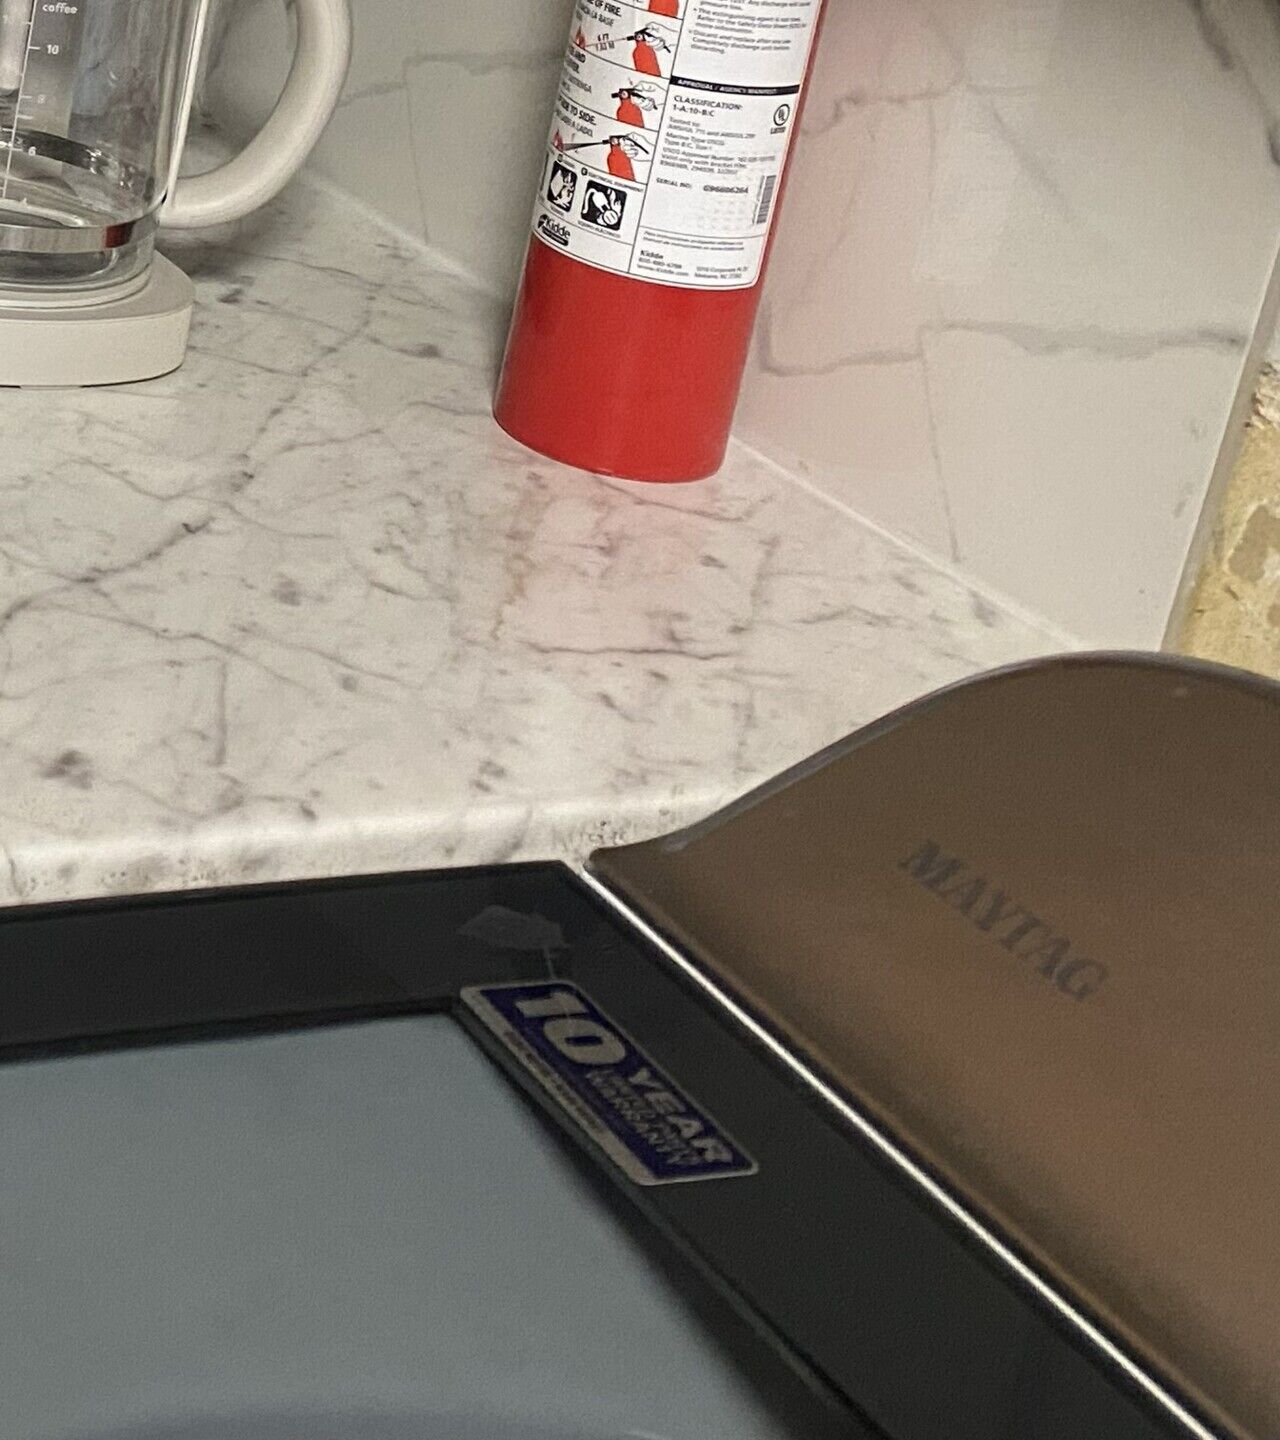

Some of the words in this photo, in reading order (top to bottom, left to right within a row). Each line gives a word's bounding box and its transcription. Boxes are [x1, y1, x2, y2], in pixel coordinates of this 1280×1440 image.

[42, 2, 78, 14] coffee
[46, 44, 59, 55] 10
[27, 146, 37, 157] 6
[546, 216, 571, 238] Kidde
[898, 838, 1109, 1002] MAYTAG
[514, 990, 627, 1066] 10
[628, 1067, 735, 1164] YEAR
